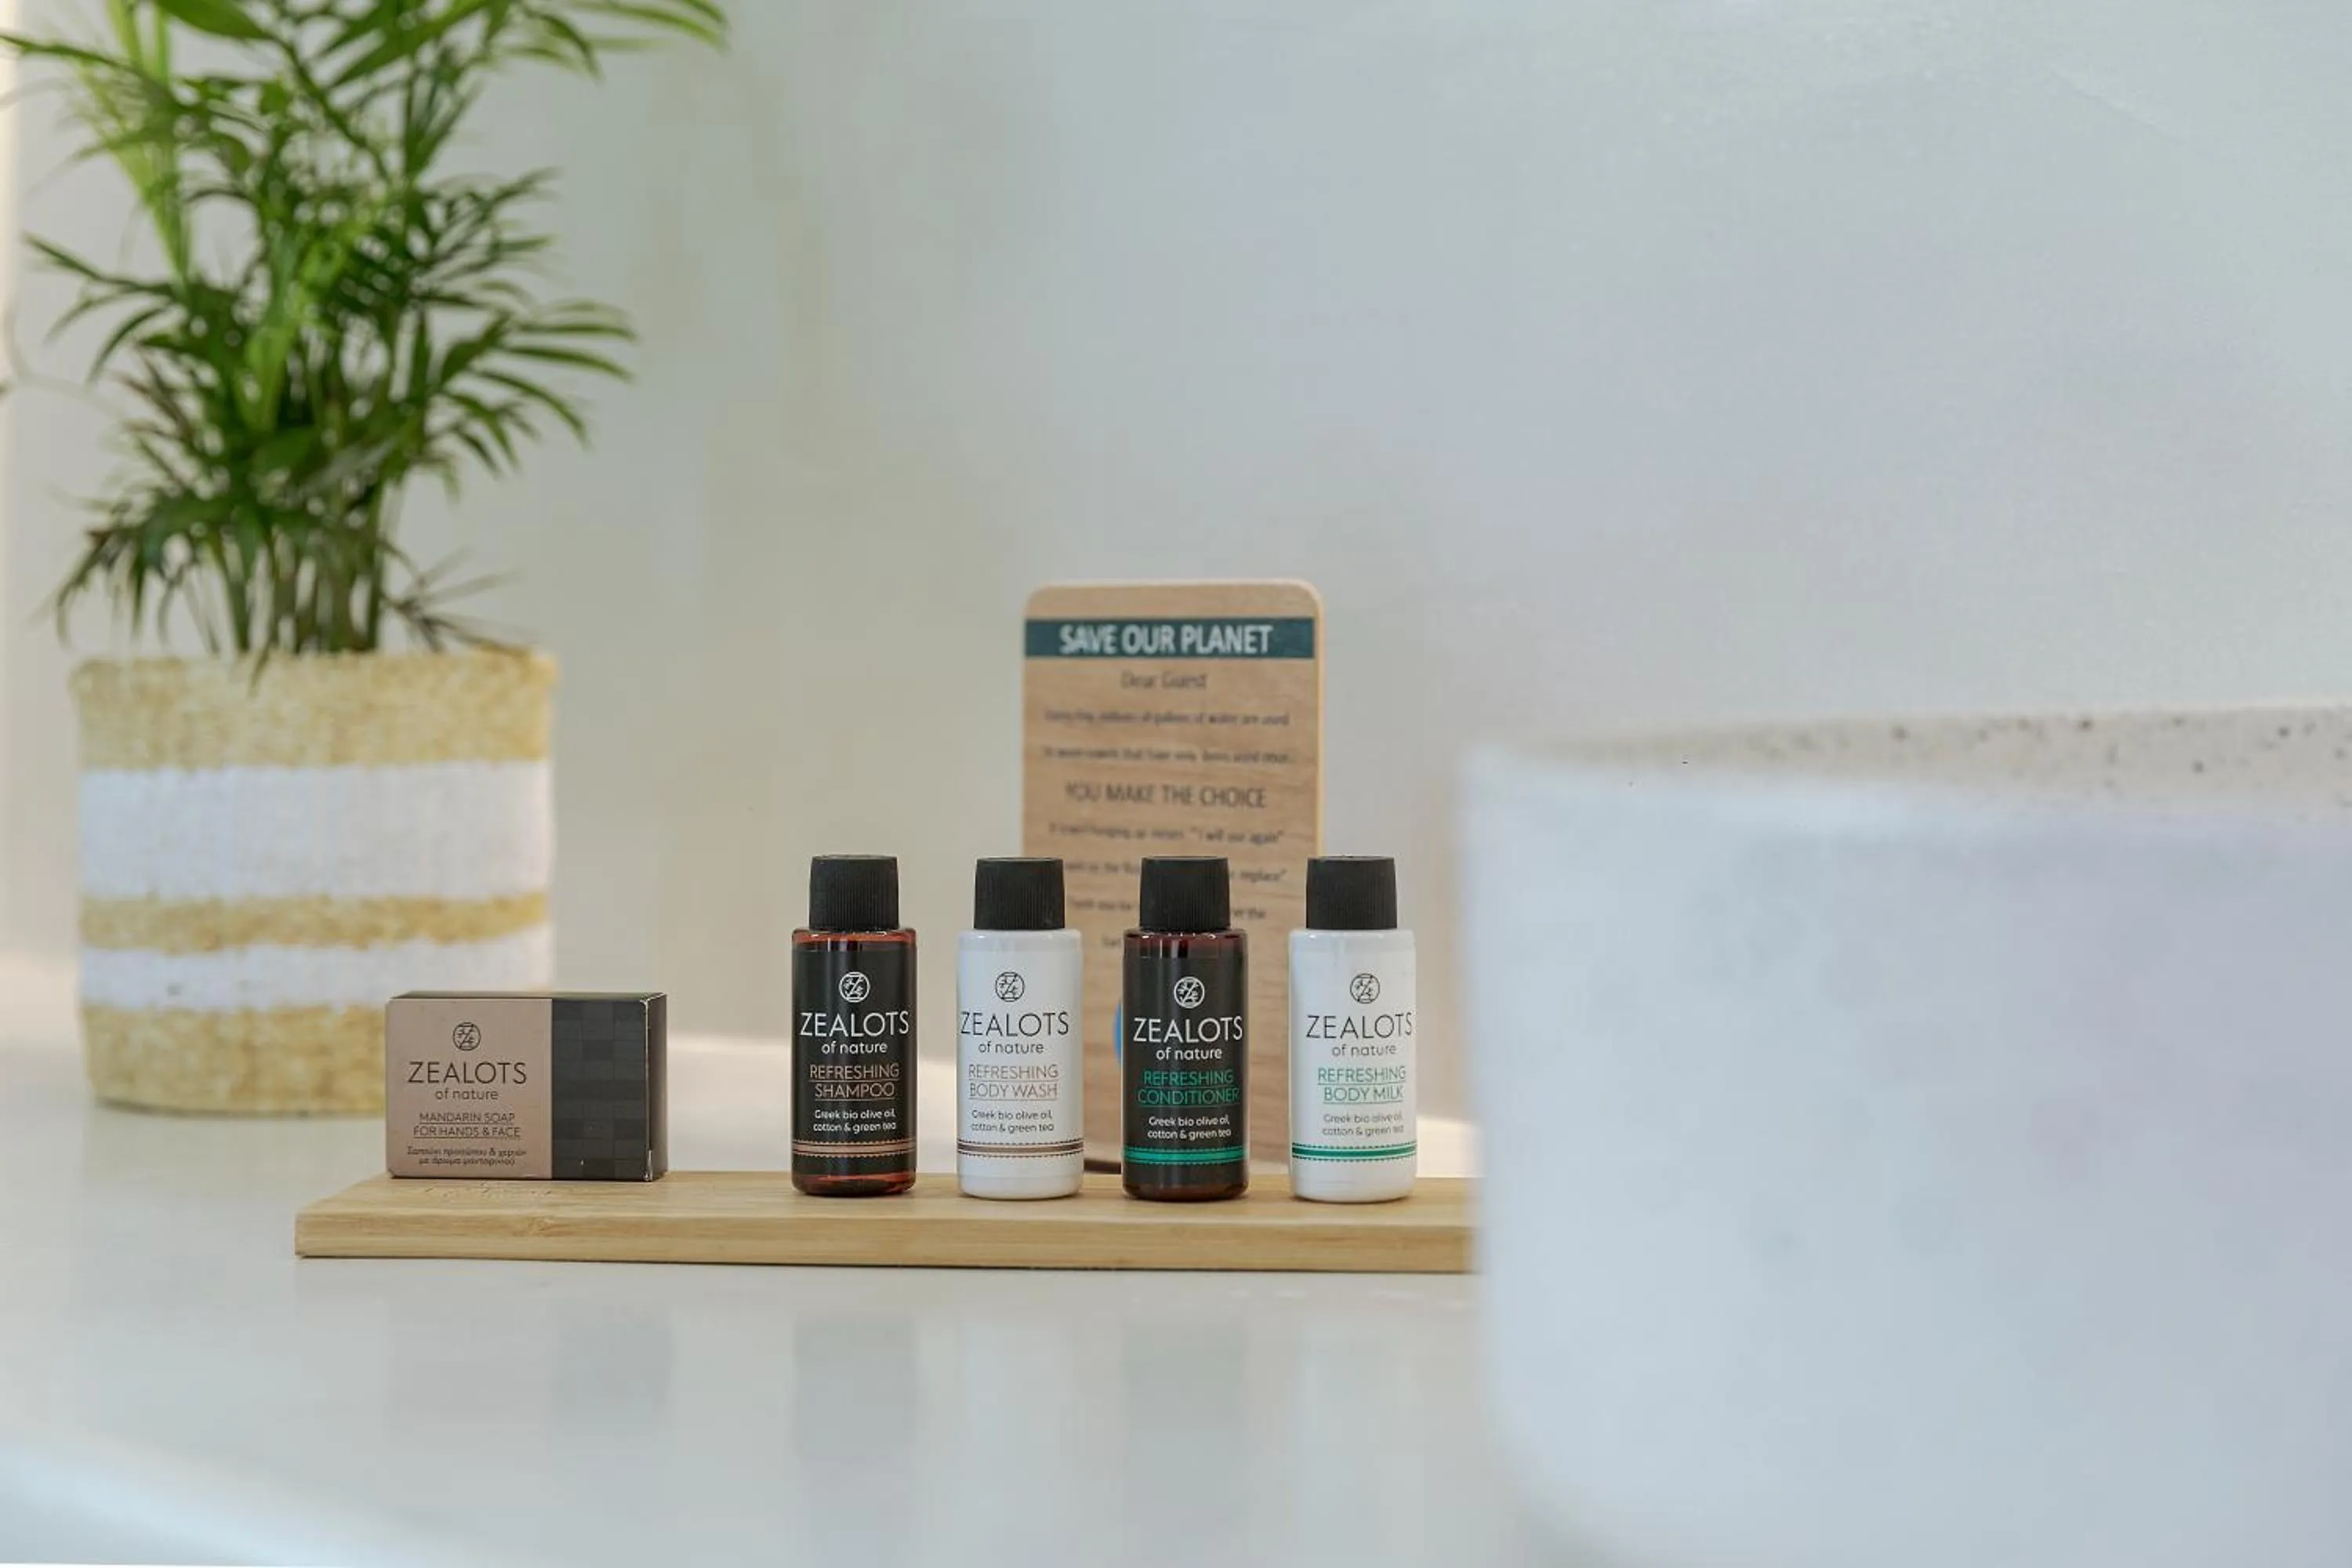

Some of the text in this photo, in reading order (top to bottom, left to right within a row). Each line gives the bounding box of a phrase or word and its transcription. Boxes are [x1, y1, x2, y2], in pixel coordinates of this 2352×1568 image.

[1059, 624, 1273, 655] SAVE OUR PLANET
[1120, 669, 1208, 690] Dear Guest
[1065, 781, 1268, 808] YOU MAKE THE CHOICE
[800, 1011, 909, 1037] ZEALOTS
[960, 1011, 1069, 1037] ZEALOTS
[1133, 1016, 1243, 1043] ZEALOTS
[1306, 1012, 1414, 1039] ZEALOTS
[822, 1041, 887, 1054] of nature
[978, 1041, 1044, 1054] of nature
[1156, 1047, 1223, 1060] of nature
[1331, 1044, 1397, 1057] of nature
[408, 1062, 528, 1084] ZEALOTS
[809, 1063, 900, 1080] REFRESHING
[968, 1063, 1058, 1080] REFRESHING
[1144, 1069, 1234, 1086] REFRESHING
[1317, 1065, 1406, 1083] REFRESHING
[435, 1089, 499, 1100] of nature
[815, 1083, 895, 1098] SHAMPOO
[969, 1083, 1058, 1098] BODY WASH
[1138, 1087, 1240, 1105] CONDITIONER
[1324, 1087, 1403, 1102] BODY MILK
[419, 1112, 515, 1122] MANDARIN SOAP
[815, 1109, 840, 1120] Greek
[843, 1109, 858, 1120] bio
[860, 1109, 883, 1120] olive
[971, 1109, 996, 1120] Greek
[998, 1109, 1014, 1120] bio
[1015, 1109, 1039, 1120] olive
[1149, 1116, 1176, 1127] Greek
[1178, 1116, 1193, 1127] bio
[1196, 1116, 1219, 1127] olive
[1323, 1113, 1352, 1123] Greek
[1354, 1113, 1370, 1123] bio
[1371, 1113, 1392, 1123] olive
[413, 1126, 521, 1137] FOR HANDS & FACE
[813, 1122, 897, 1134] cotton & green tea
[971, 1123, 1054, 1134] cotton & green tea
[1147, 1129, 1178, 1138] cotton
[1179, 1129, 1187, 1138] &
[1189, 1131, 1217, 1141] green
[1322, 1127, 1354, 1136] cotton
[1356, 1127, 1363, 1136] &
[1364, 1127, 1391, 1137] green
[488, 1147, 495, 1156] &
